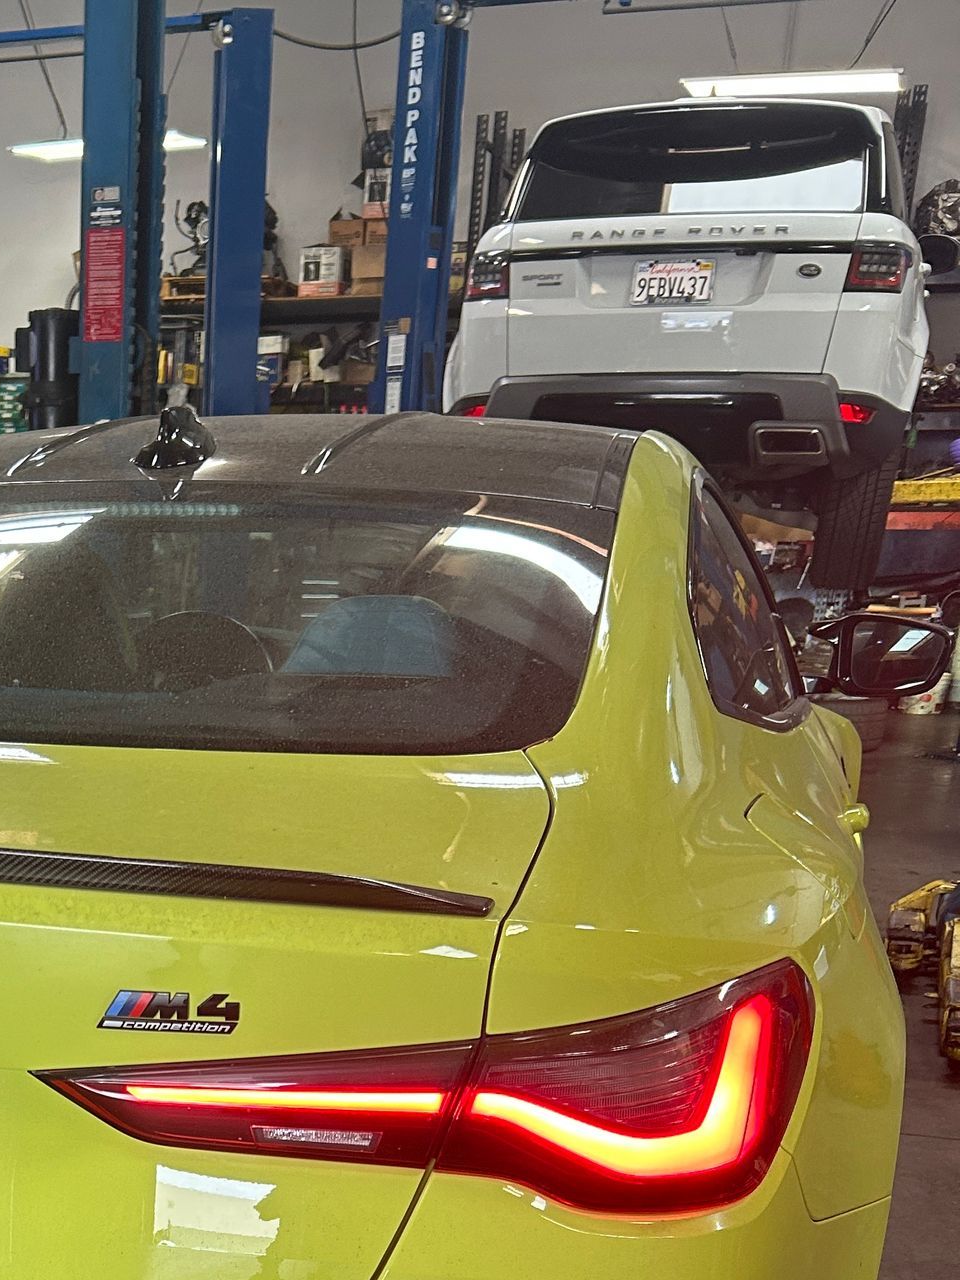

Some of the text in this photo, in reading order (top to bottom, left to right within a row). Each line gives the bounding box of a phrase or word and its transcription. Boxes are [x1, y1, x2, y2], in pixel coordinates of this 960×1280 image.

[407, 31, 426, 105] BEND
[403, 109, 420, 163] PAK
[570, 225, 791, 241] RANGE ROVER
[522, 273, 563, 281] SPORT
[636, 276, 708, 298] 9EBV437
[123, 1020, 231, 1033] competition
